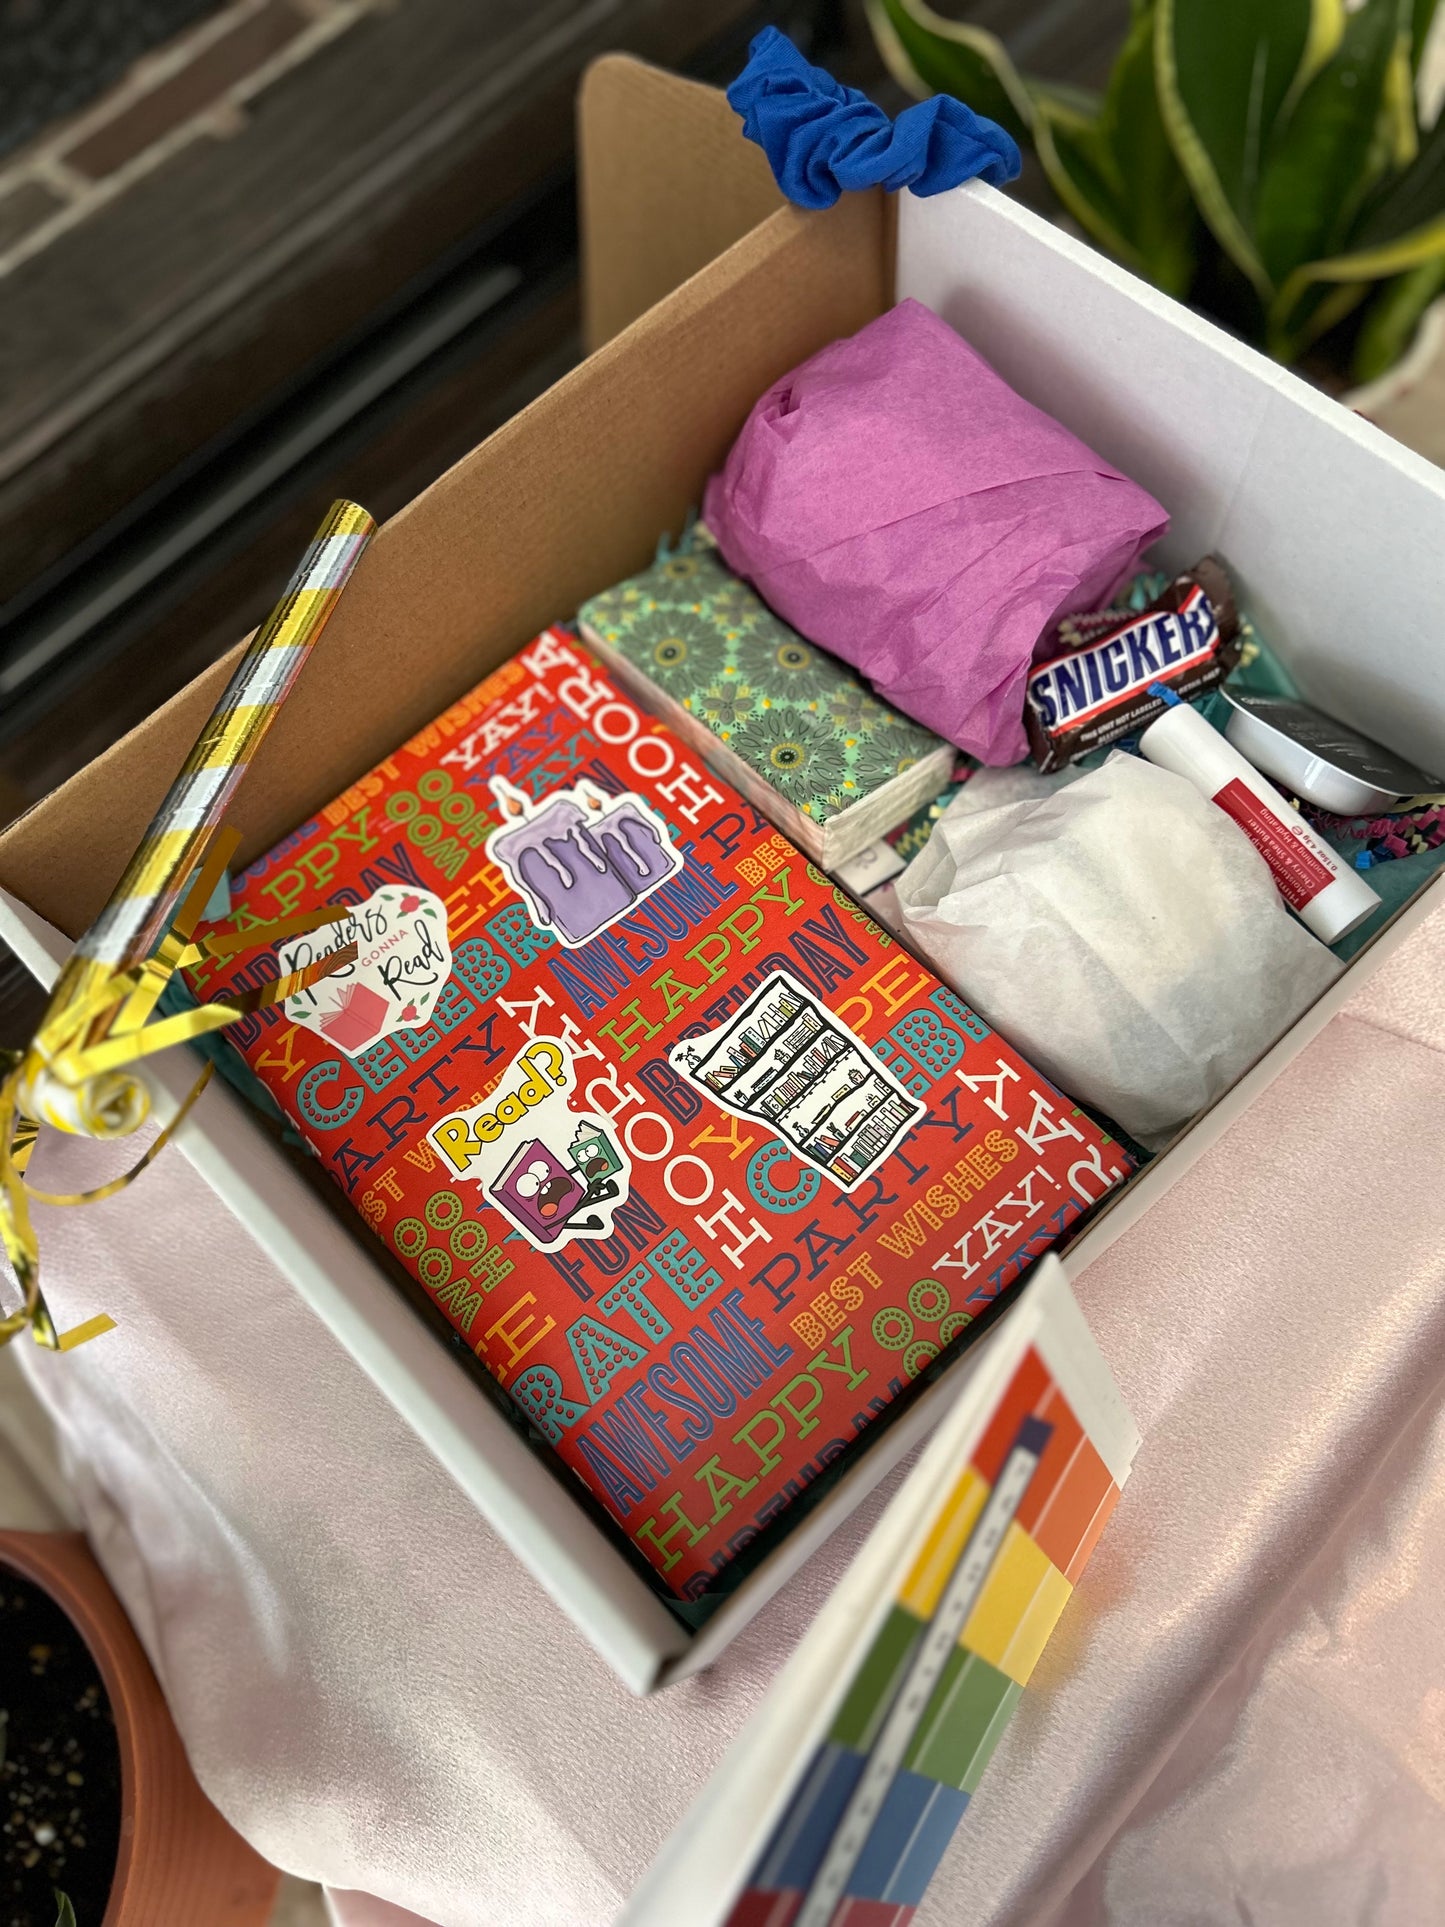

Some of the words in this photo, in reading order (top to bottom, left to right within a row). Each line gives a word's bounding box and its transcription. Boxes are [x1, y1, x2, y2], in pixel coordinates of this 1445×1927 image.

[1030, 593, 1216, 727] SNICKERS
[1248, 818, 1270, 842] Butter
[1260, 808, 1293, 844] Hydrating
[1269, 840, 1286, 860] Shea
[1292, 864, 1315, 889] Cherry
[1297, 846, 1328, 880] Soothing
[361, 929, 409, 968] GONNA
[377, 919, 445, 1001] Read
[598, 866, 805, 1062] HAPPY
[433, 1041, 568, 1172] Read?
[750, 1086, 975, 1314] PARTY
[789, 1251, 884, 1351] BEST
[876, 1129, 1019, 1260] WISHES
[931, 1164, 1062, 1281] YAY!
[576, 1287, 794, 1517] AWESOME
[636, 1325, 871, 1573] HAPPY
